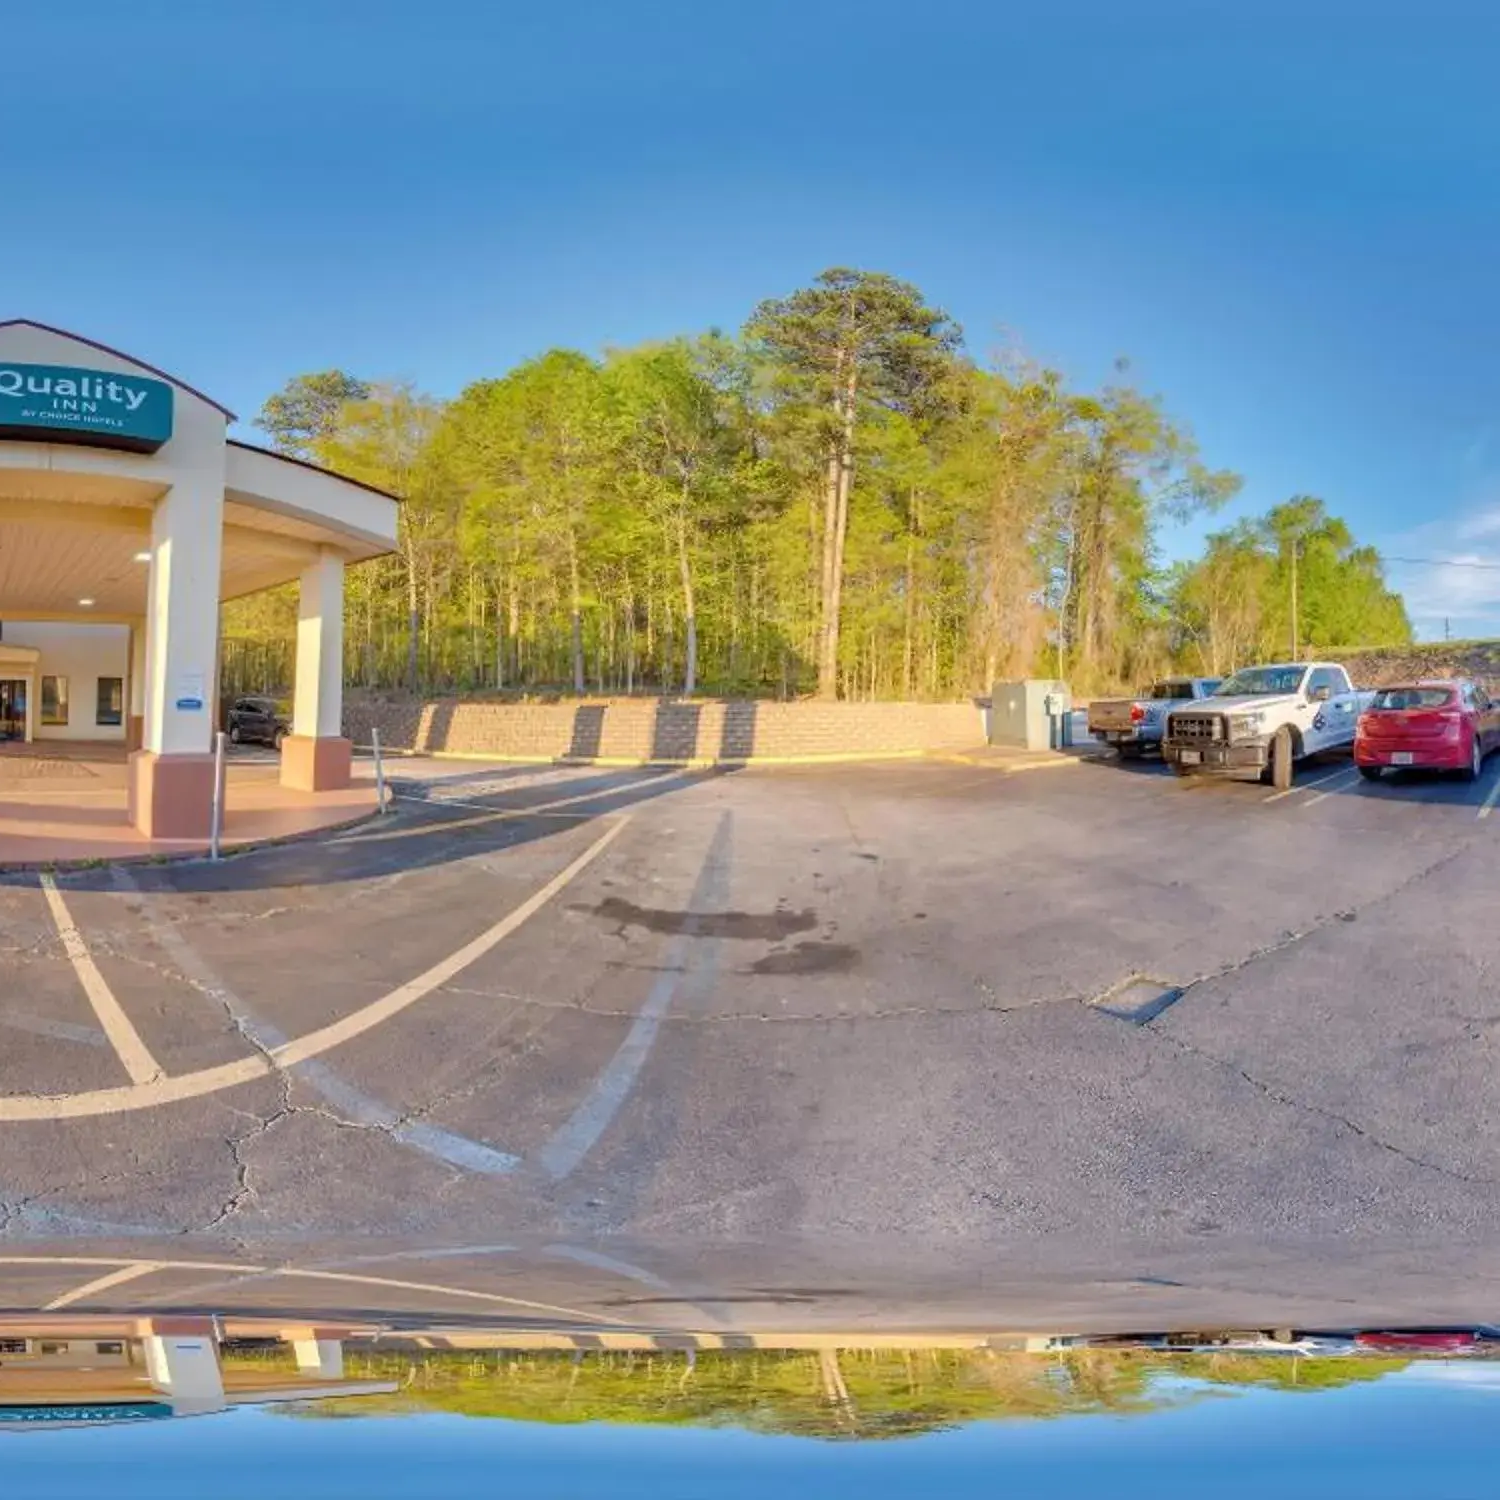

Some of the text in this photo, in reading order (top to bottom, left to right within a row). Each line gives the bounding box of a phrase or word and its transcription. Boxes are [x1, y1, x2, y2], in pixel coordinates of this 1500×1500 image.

[53, 398, 97, 413] INN
[39, 411, 81, 421] CHOICE
[83, 415, 124, 427] HOTELS
